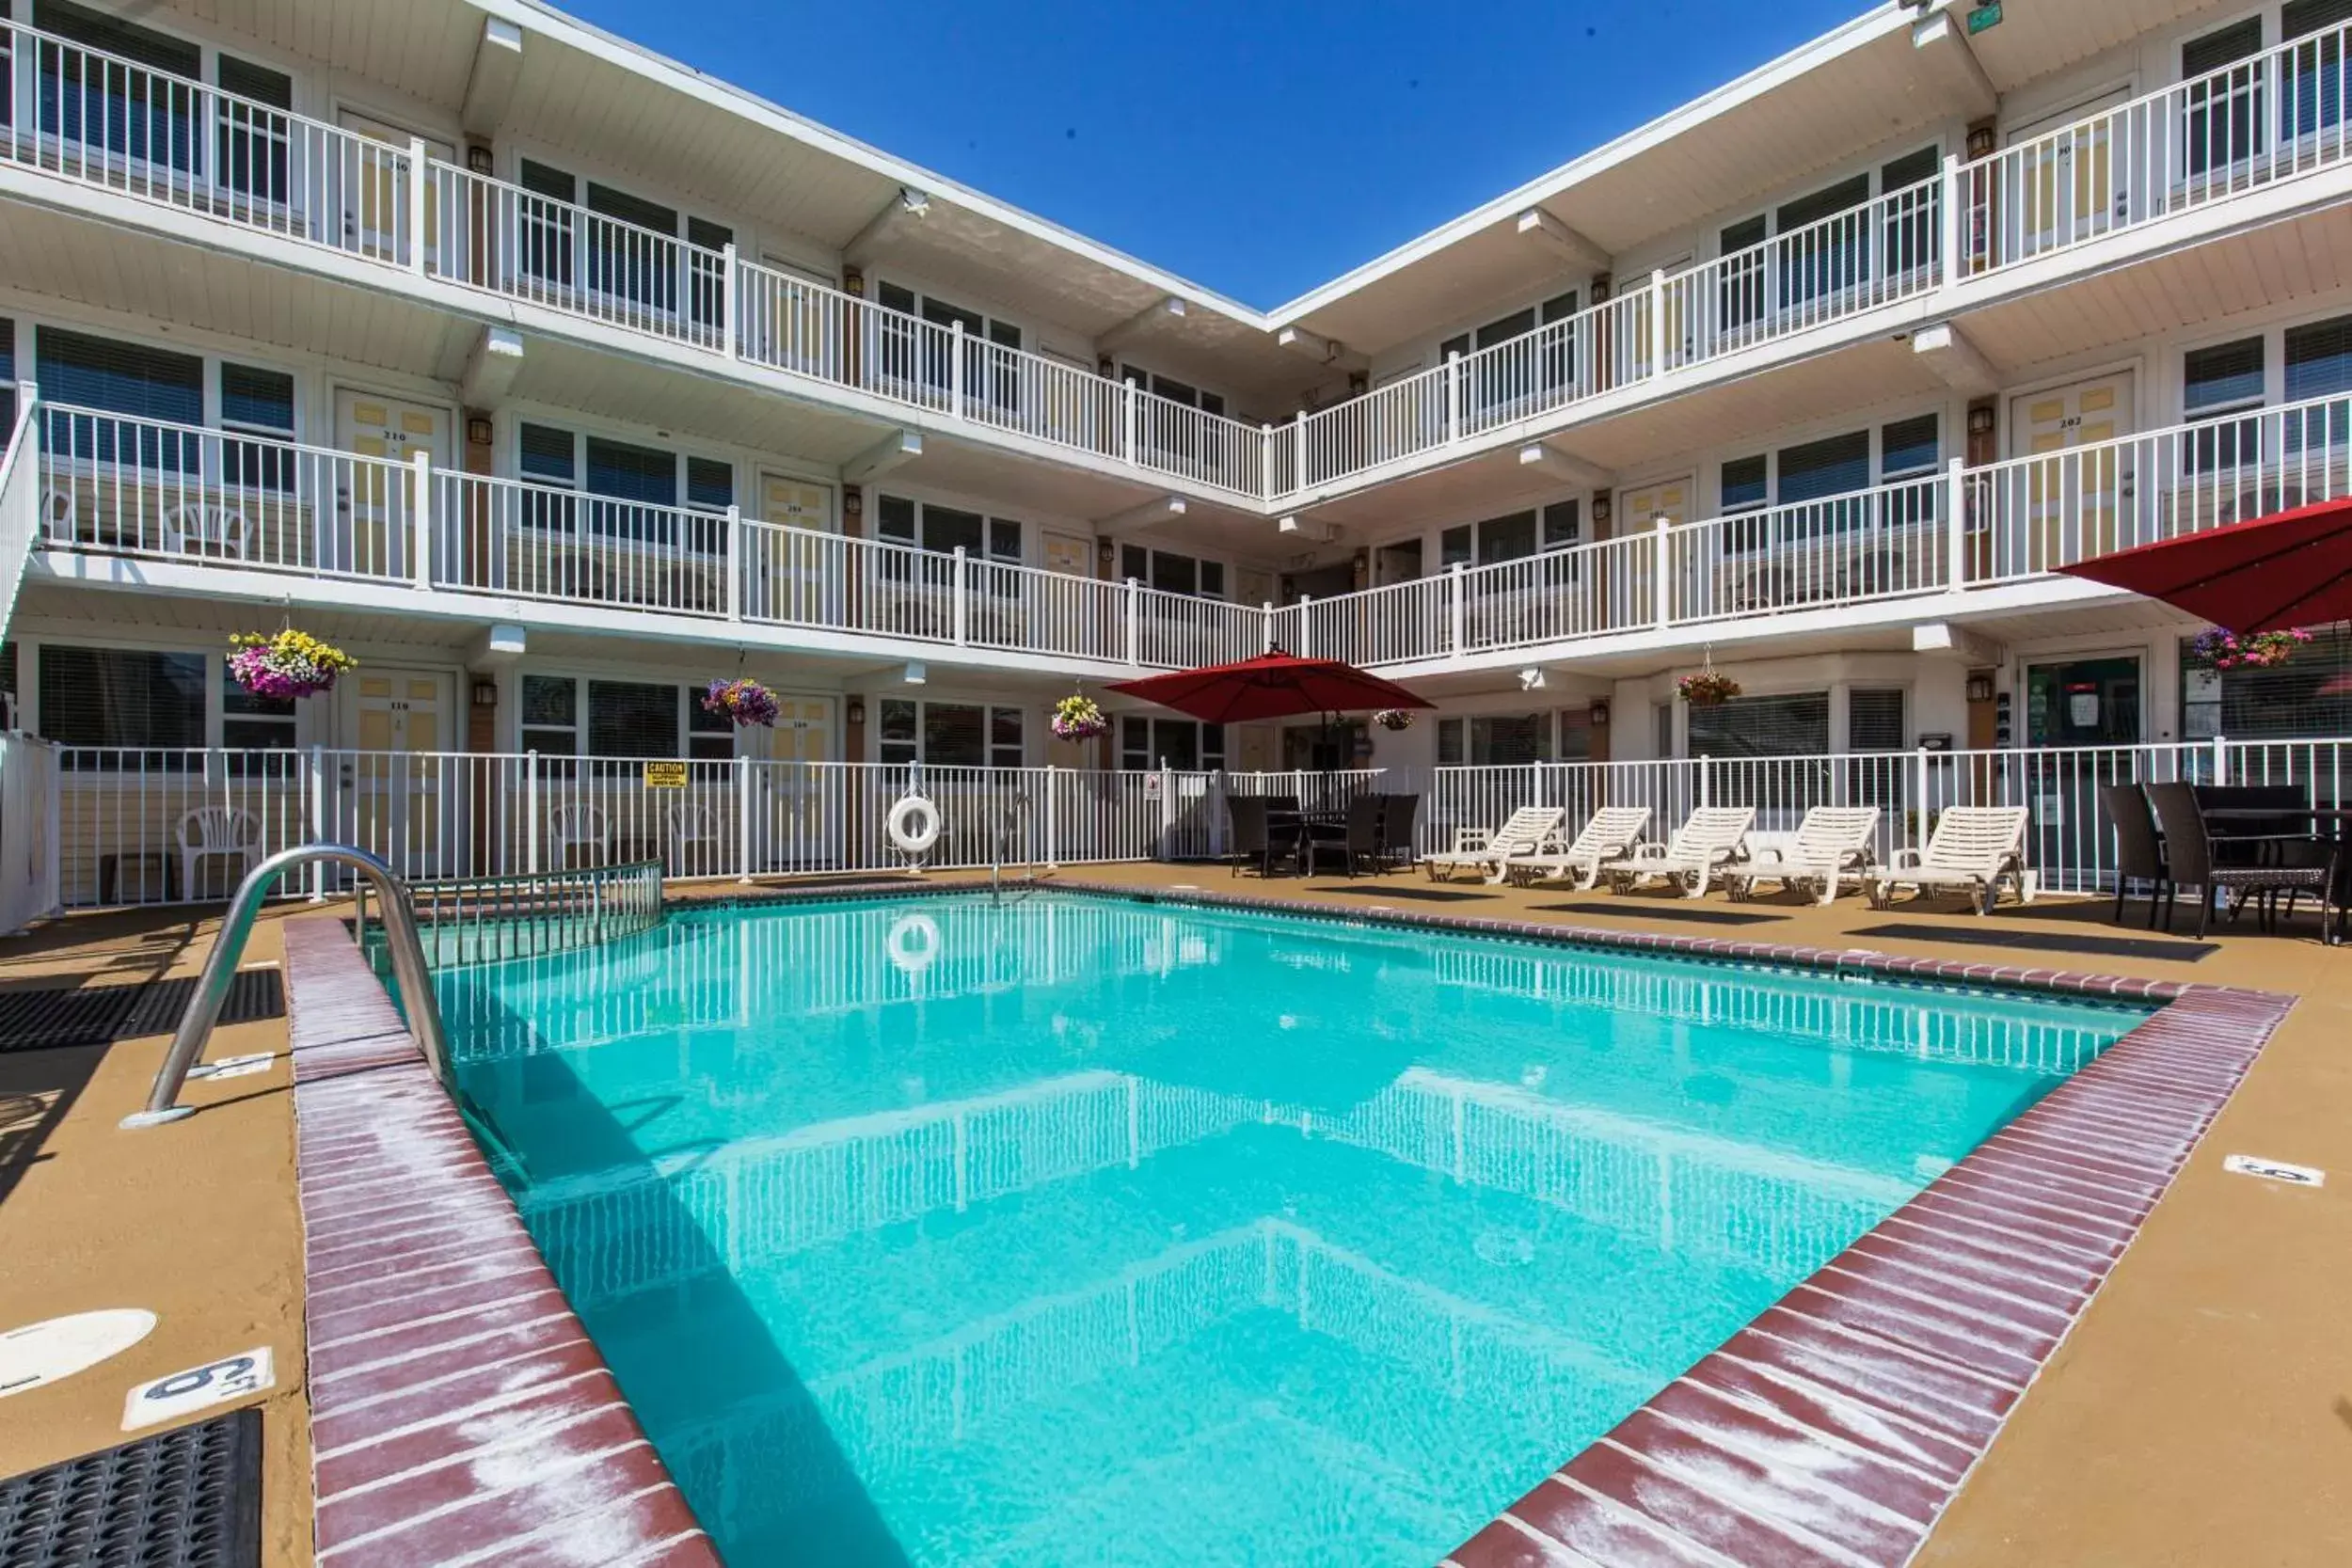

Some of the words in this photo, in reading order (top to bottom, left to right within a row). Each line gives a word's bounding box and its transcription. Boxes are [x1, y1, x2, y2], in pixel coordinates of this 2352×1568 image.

[2060, 417, 2081, 429] 202
[391, 701, 408, 710] 110
[649, 763, 683, 772] CAUTION
[144, 1356, 256, 1401] 6
